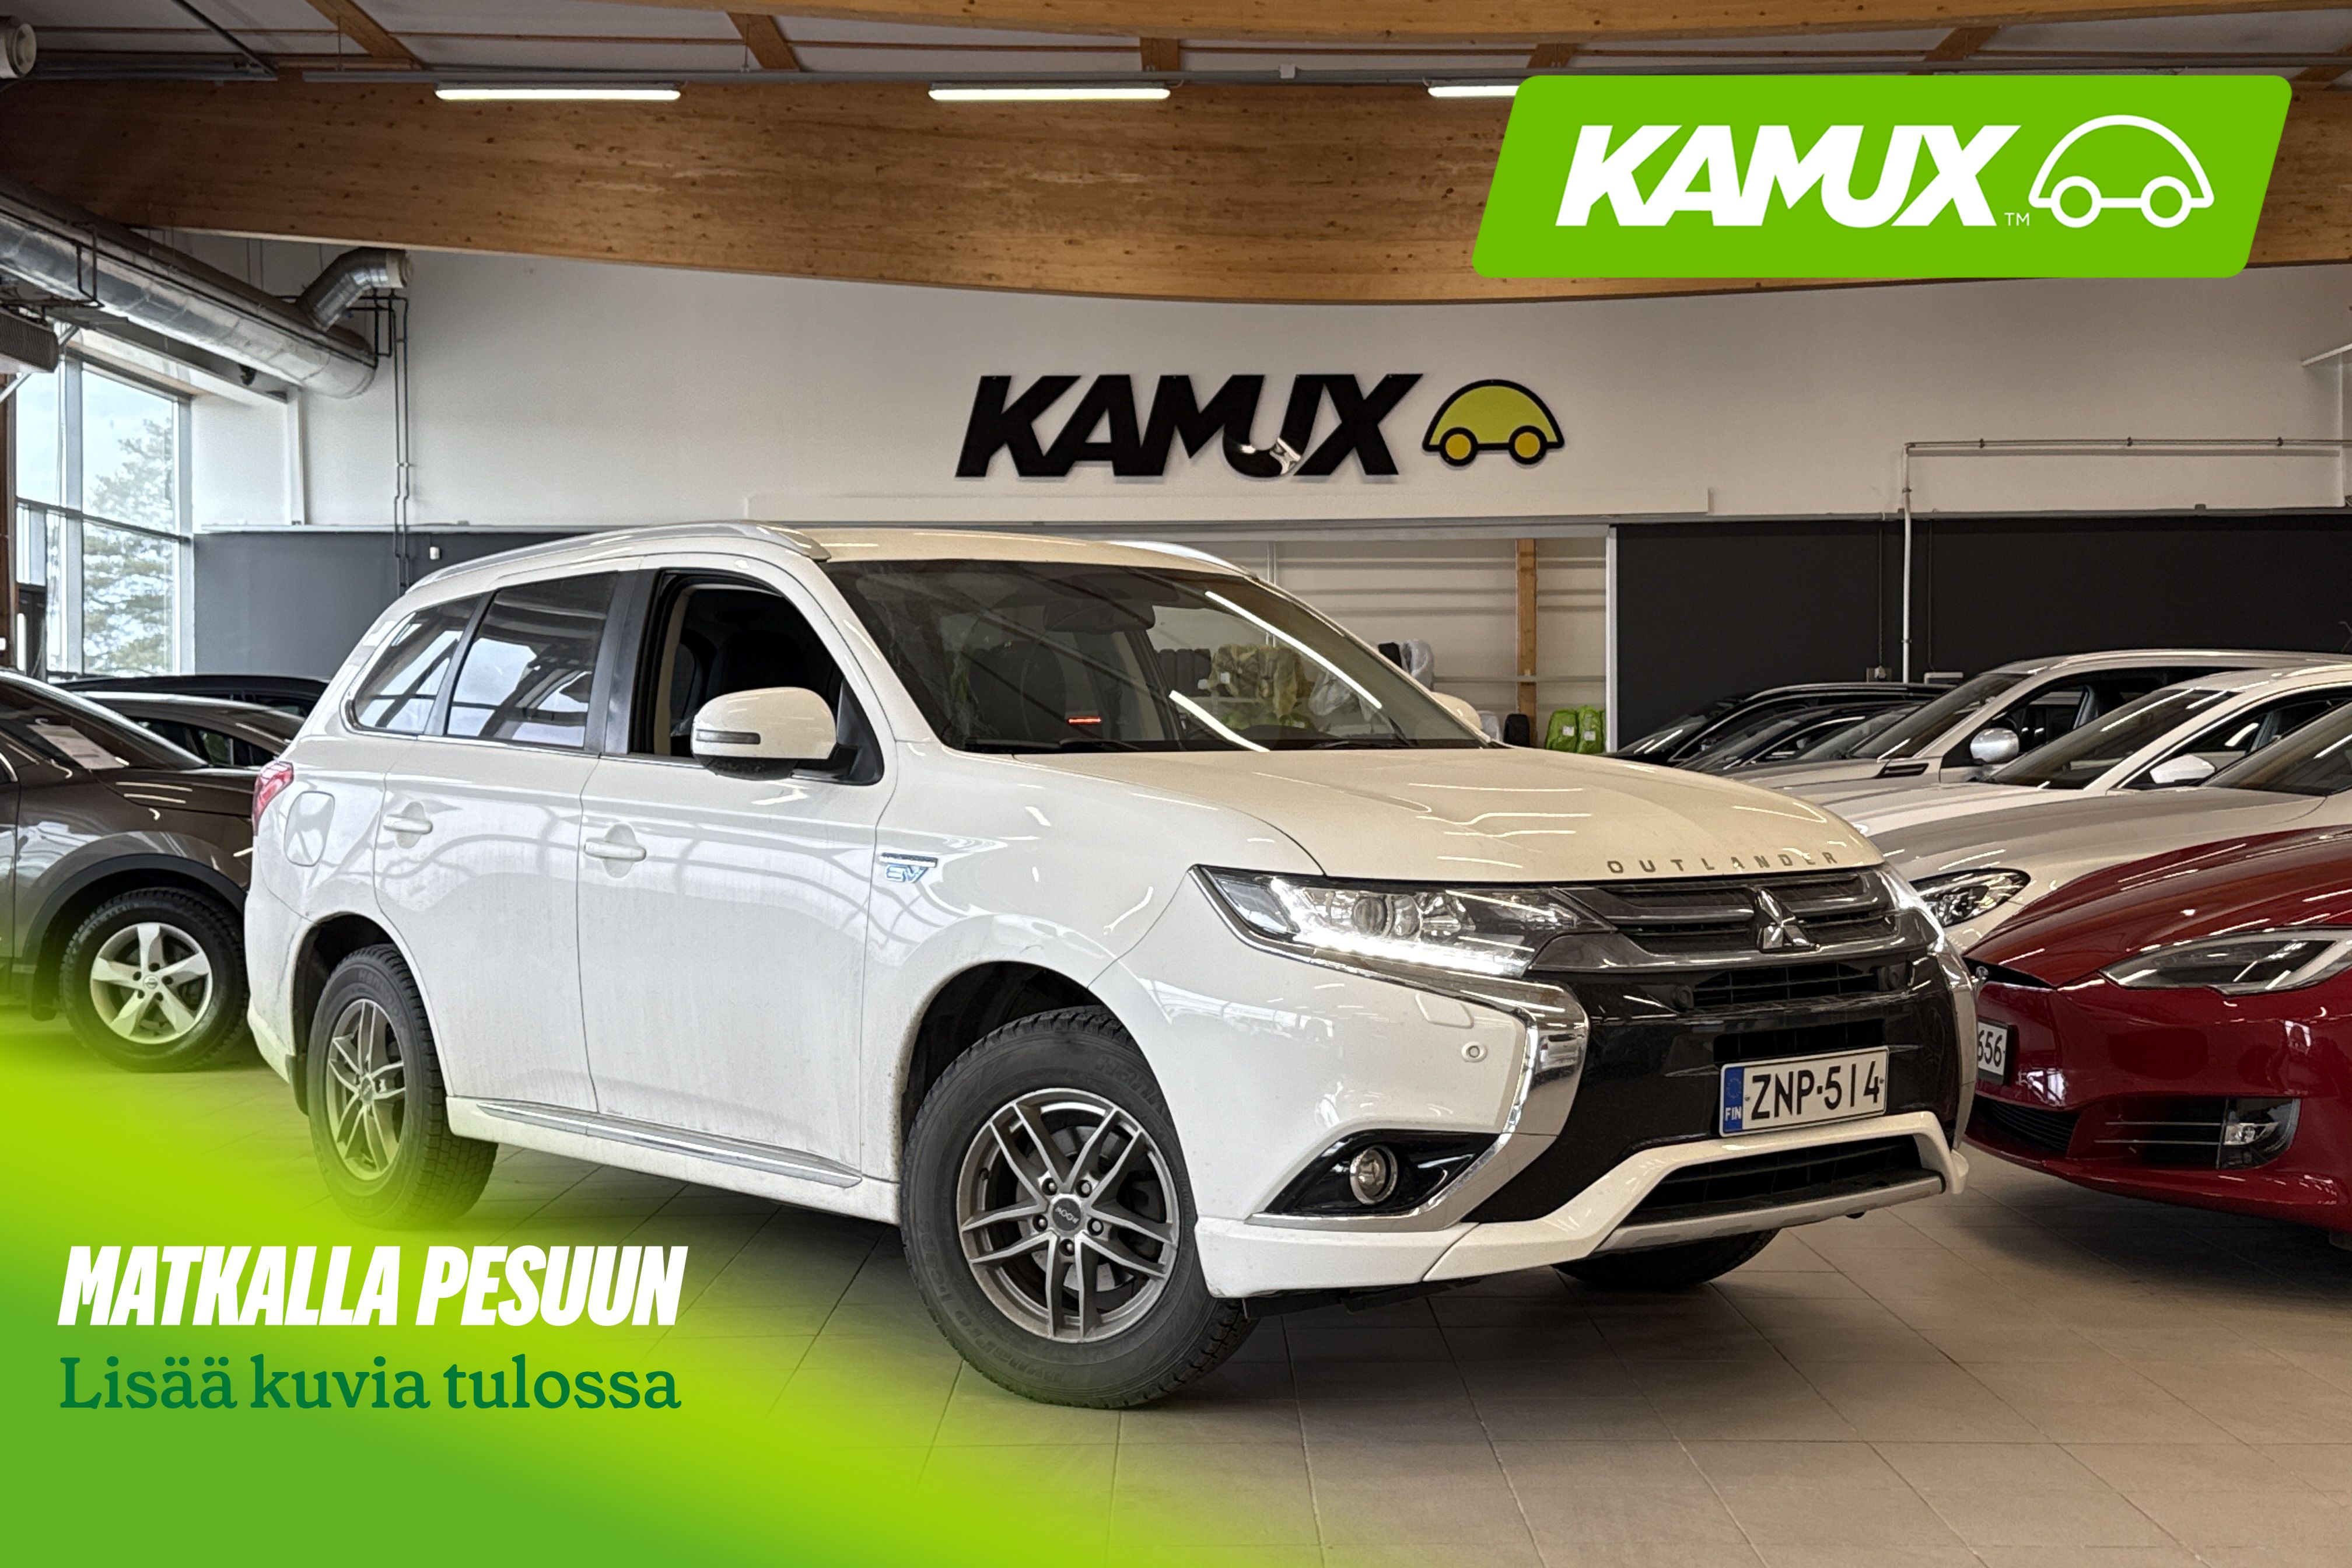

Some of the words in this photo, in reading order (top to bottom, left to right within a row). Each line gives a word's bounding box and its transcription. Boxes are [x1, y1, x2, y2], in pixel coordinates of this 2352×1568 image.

[956, 373, 1423, 478] KAMUX
[1606, 851, 1838, 874] OUTLANDER
[1751, 1060, 1880, 1121] ZNP-514
[1725, 1106, 1741, 1121] FIN
